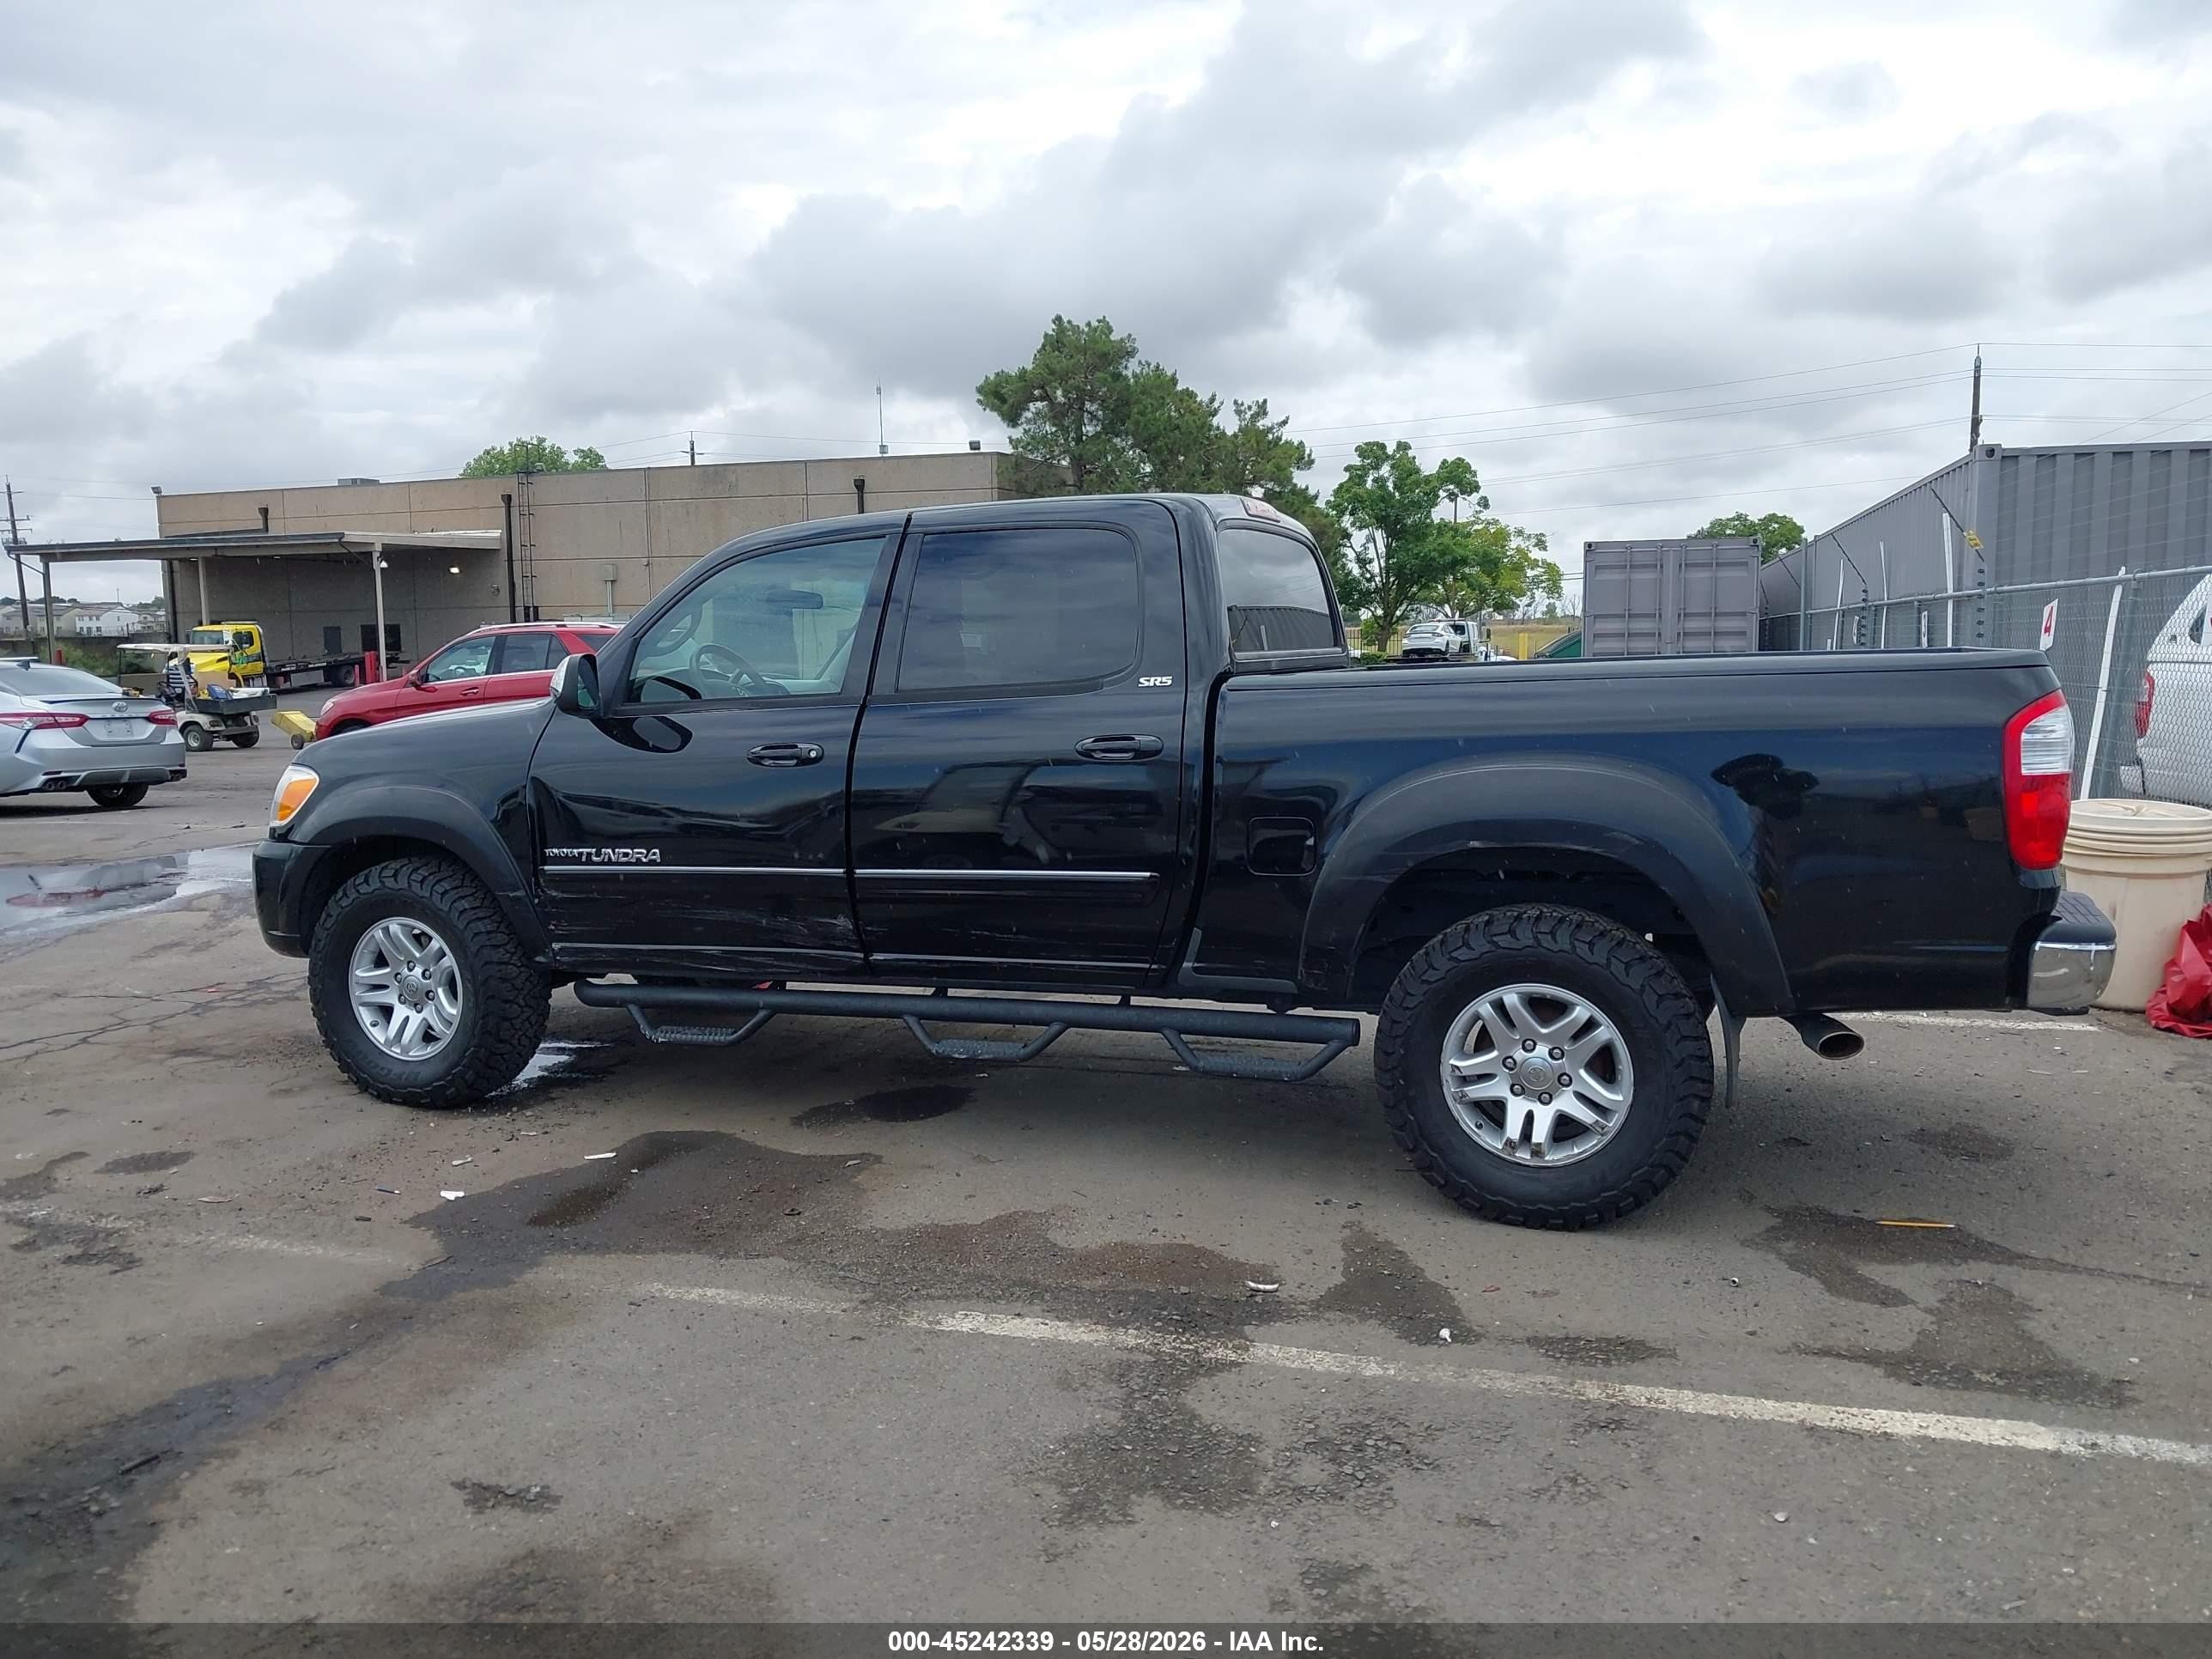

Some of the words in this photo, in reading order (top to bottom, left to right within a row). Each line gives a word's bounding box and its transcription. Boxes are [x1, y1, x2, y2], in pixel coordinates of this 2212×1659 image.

[2043, 605, 2054, 637] 4
[1138, 676, 1173, 687] SR5
[544, 848, 579, 857] TOYOTA
[577, 848, 661, 863] TUNDRA
